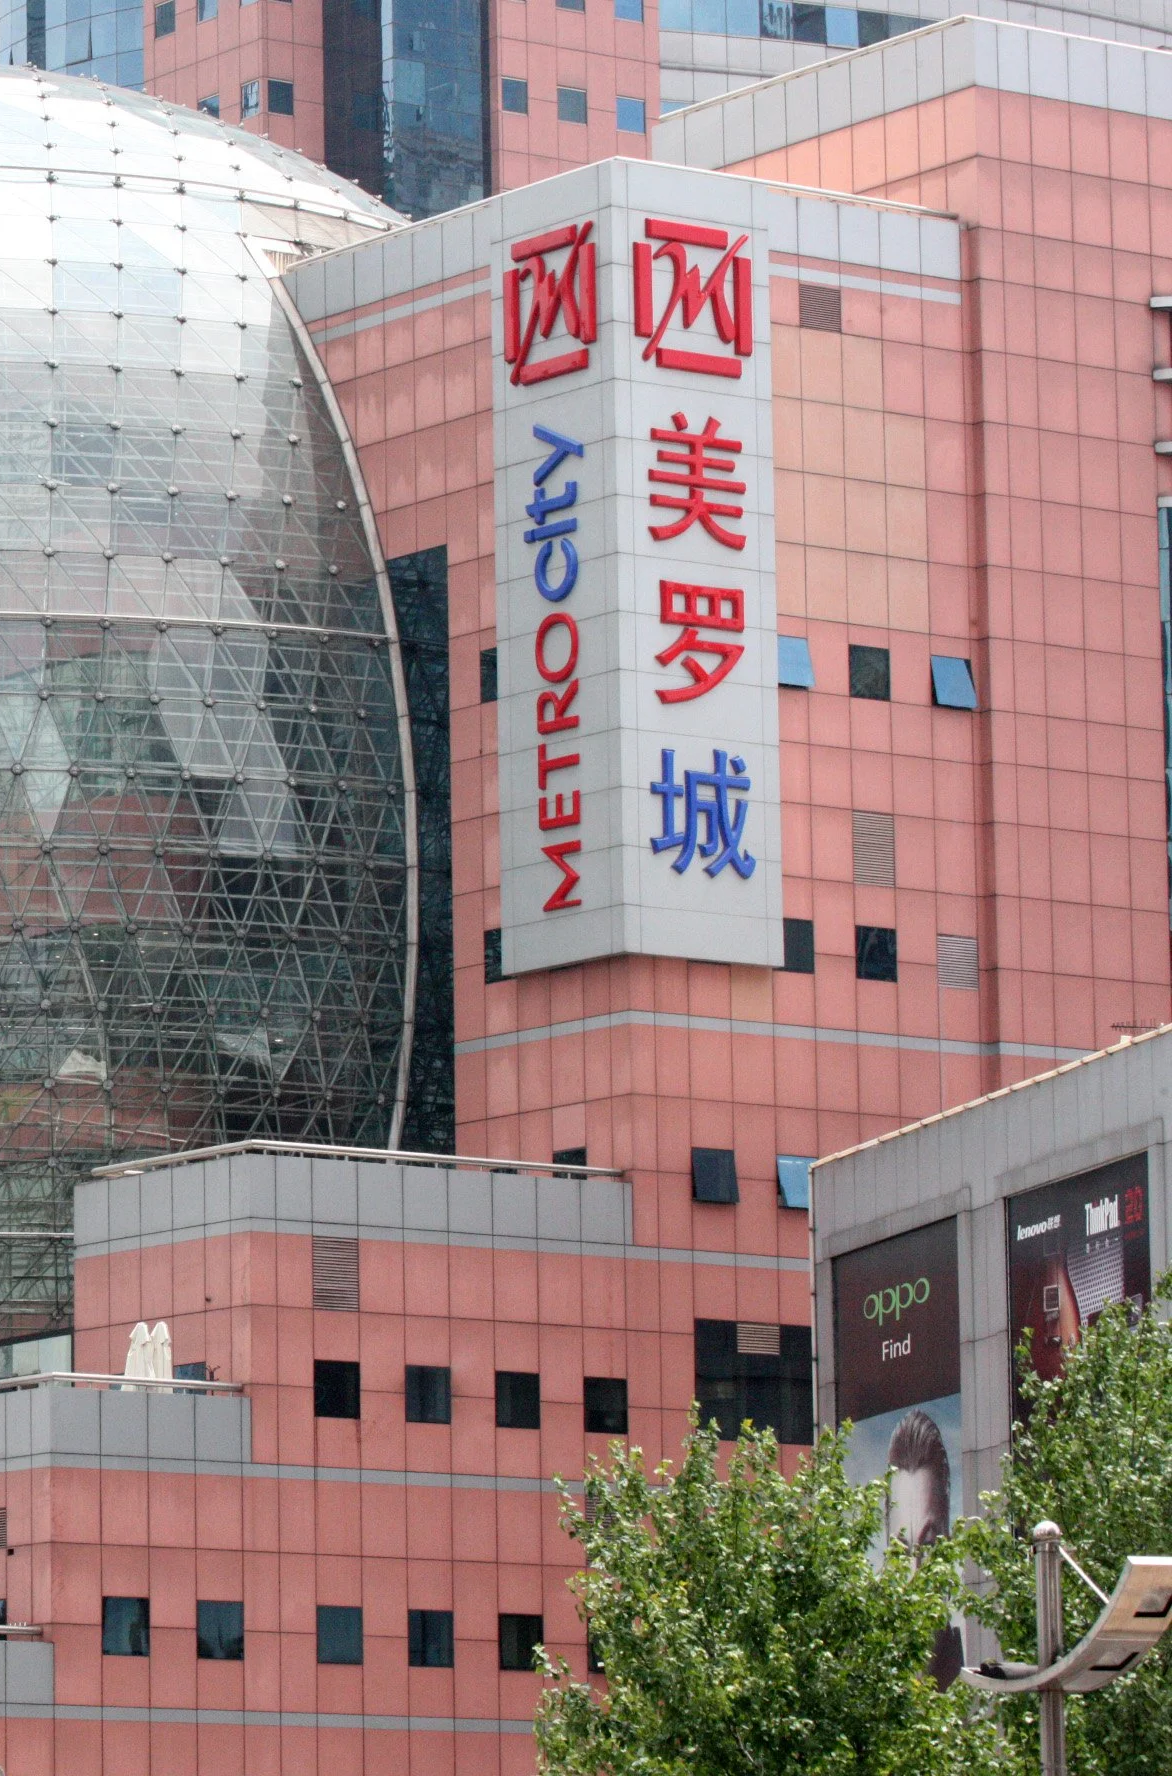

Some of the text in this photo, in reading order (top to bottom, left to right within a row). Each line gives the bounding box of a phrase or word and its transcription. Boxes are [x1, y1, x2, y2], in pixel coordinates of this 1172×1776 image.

[648, 412, 756, 879] 美罗城
[535, 613, 582, 912] METRO
[1017, 1221, 1047, 1241] lenovo
[882, 1333, 912, 1362] Find
